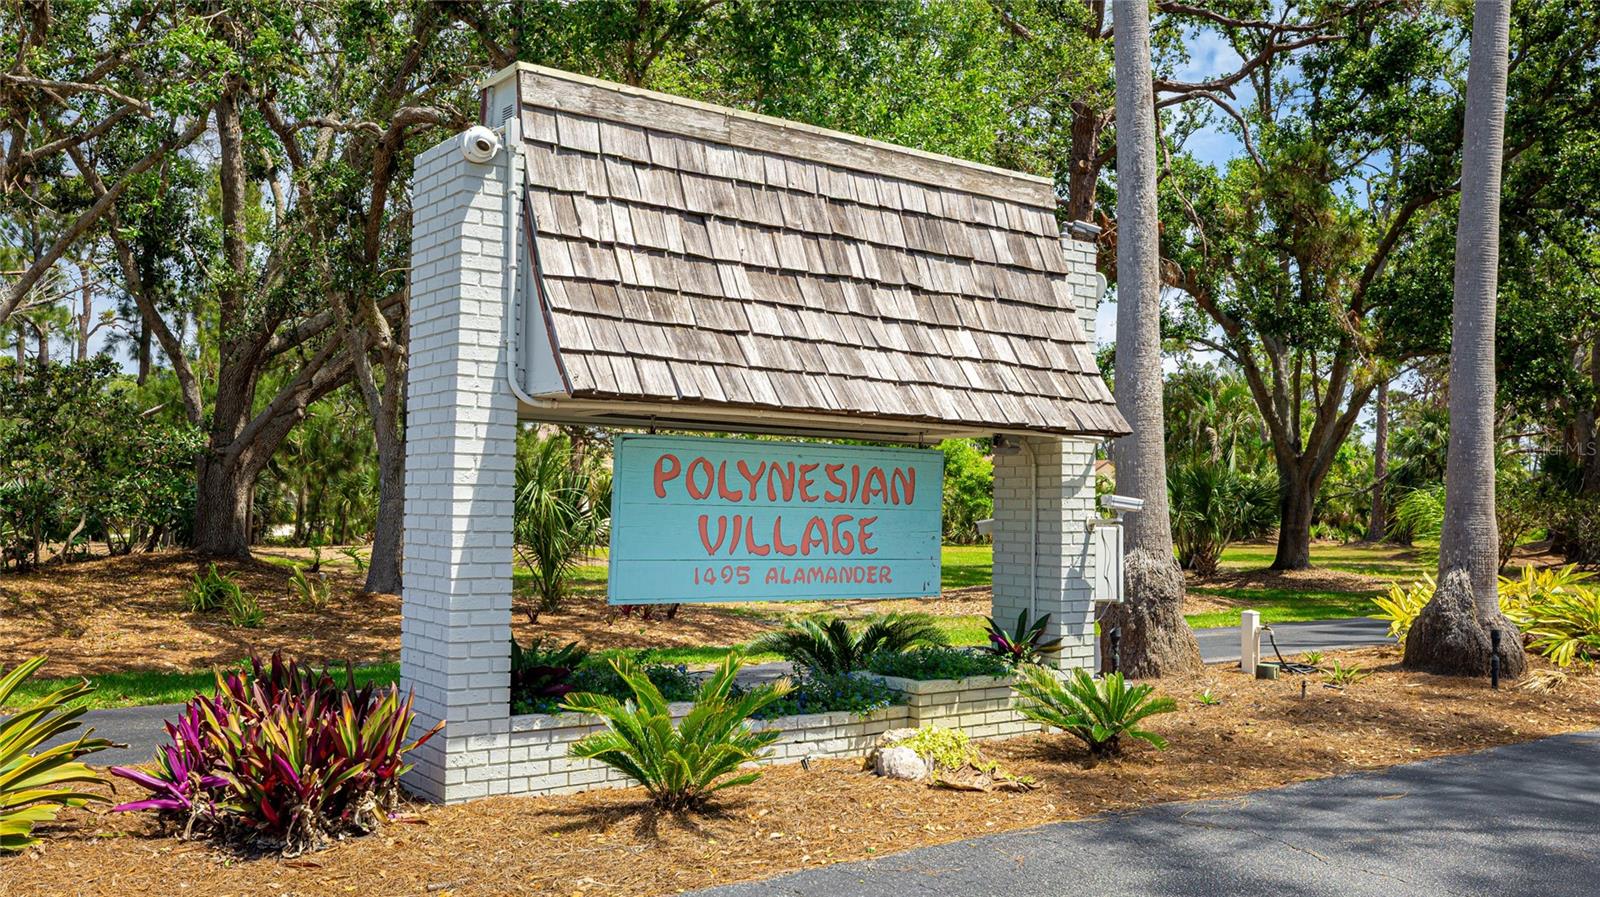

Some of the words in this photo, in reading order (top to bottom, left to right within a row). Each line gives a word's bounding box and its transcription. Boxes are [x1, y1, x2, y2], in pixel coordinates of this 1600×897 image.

[653, 453, 917, 506] POLYNESIAN
[697, 514, 879, 556] VILLAGE
[694, 565, 751, 586] 1495
[764, 565, 893, 585] ALAMANDER
